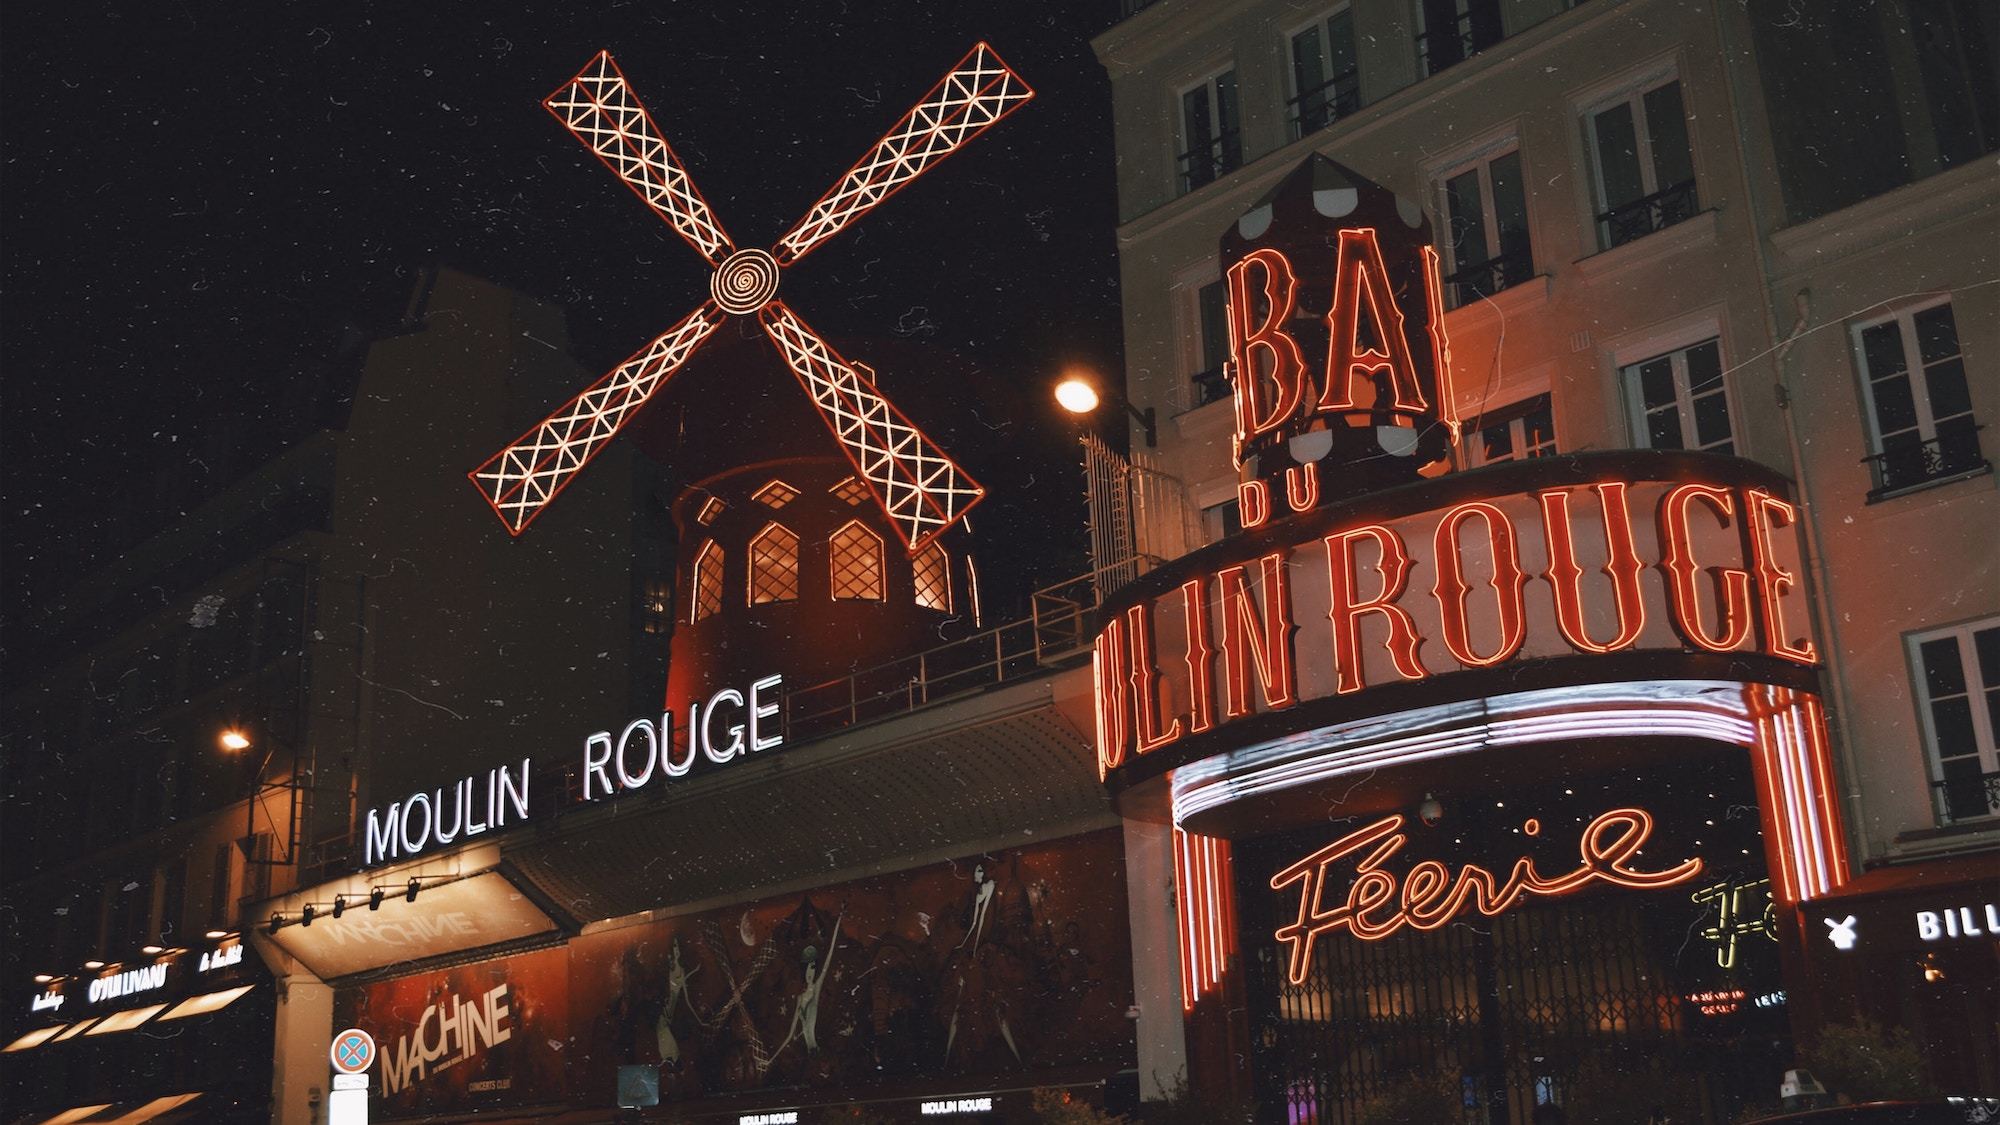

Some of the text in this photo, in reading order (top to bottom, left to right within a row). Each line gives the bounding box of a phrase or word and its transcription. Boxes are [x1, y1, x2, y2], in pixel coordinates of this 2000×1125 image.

[1237, 463, 1320, 529] DU
[1092, 480, 1818, 784] ULIN ROUGE
[364, 673, 785, 866] MOULIN ROUGE
[1269, 808, 1702, 985] Féerie
[1916, 903, 2000, 940] BILL
[380, 983, 512, 1098] MACHINE
[739, 1111, 798, 1125] MOULIN ROUGE
[920, 1097, 993, 1115] MOULIN ROUGE
